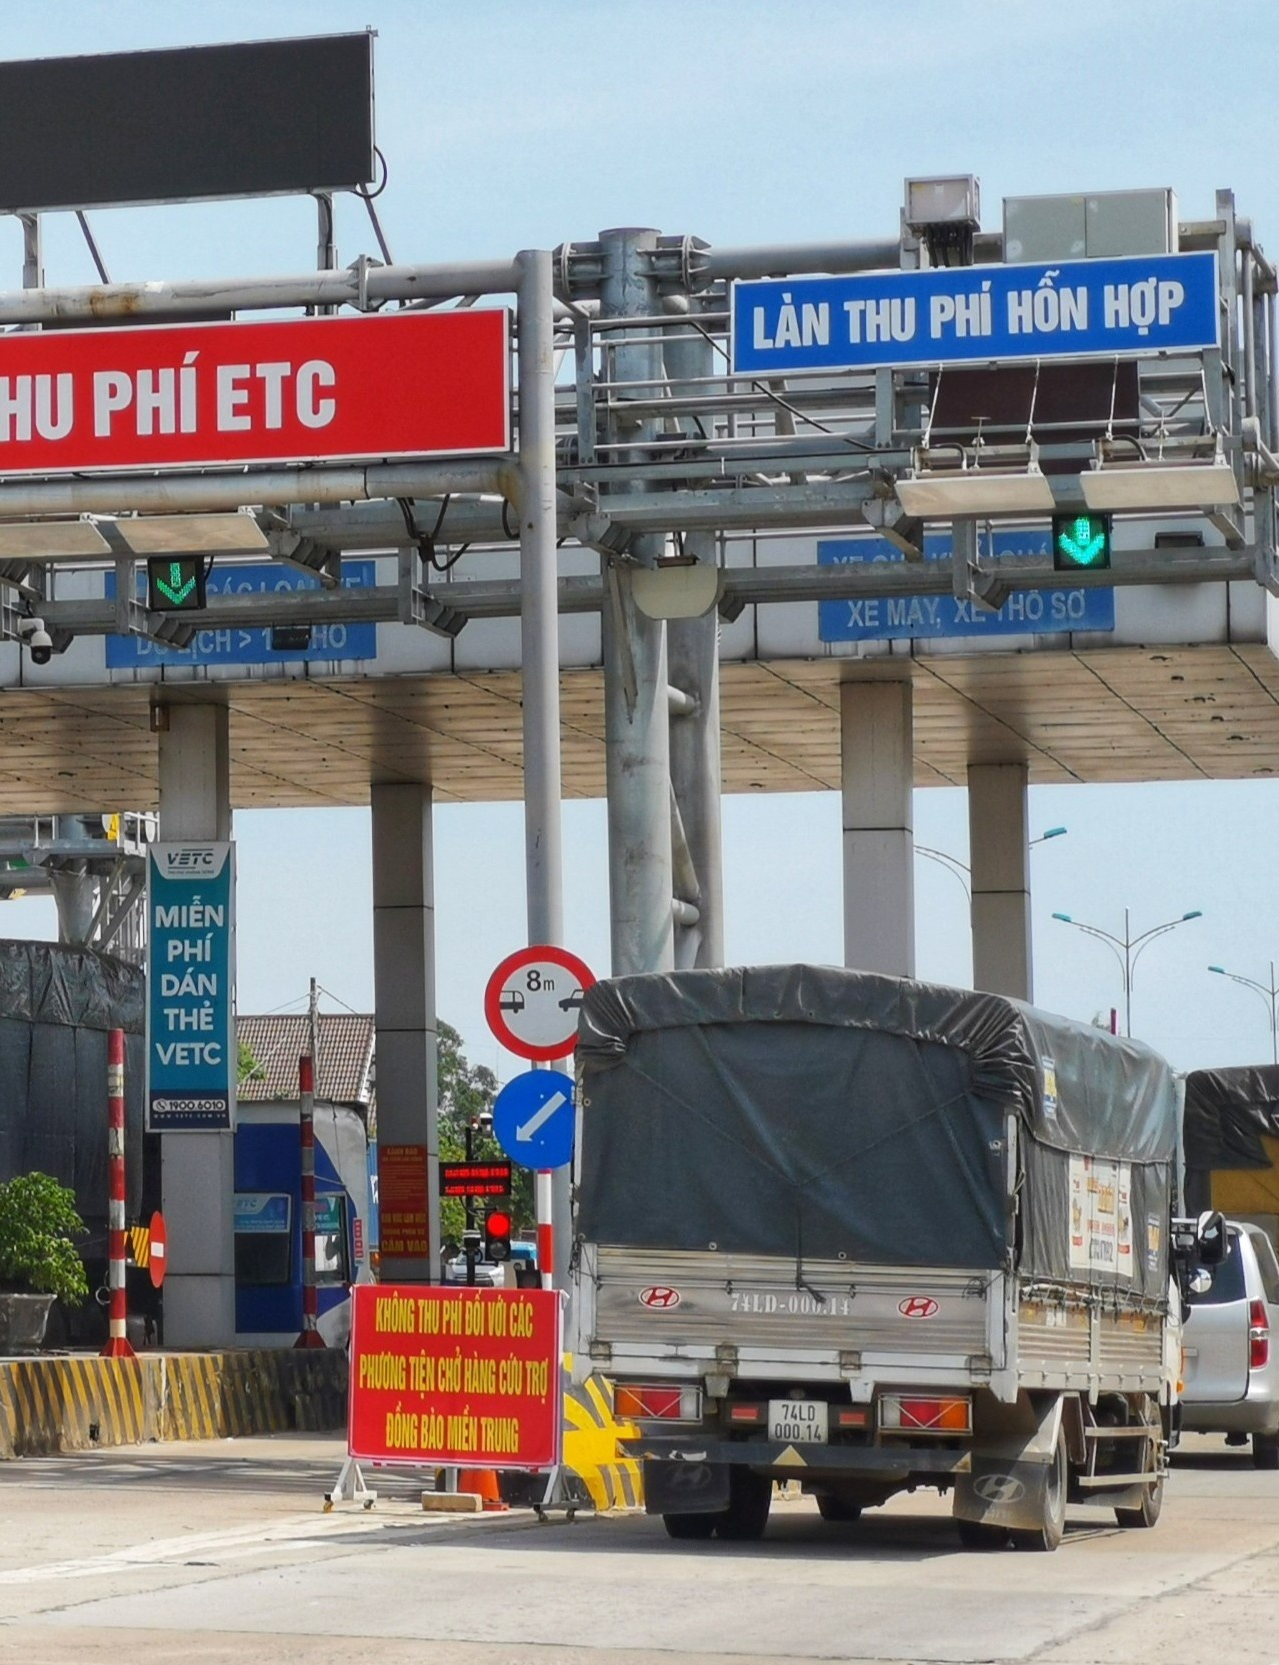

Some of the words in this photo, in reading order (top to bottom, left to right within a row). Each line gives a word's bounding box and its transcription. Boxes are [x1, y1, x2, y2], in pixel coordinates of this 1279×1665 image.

[754, 293, 829, 349] LÀN
[844, 298, 915, 343] THU
[931, 281, 991, 338] PHÍ
[1008, 270, 1087, 333] HỖN
[1104, 277, 1184, 335] HỢP
[94, 351, 199, 437] PHÍ
[217, 360, 335, 431] ETC
[847, 600, 880, 628] XE
[1052, 589, 1086, 619] SƠ
[167, 852, 214, 865] VETC
[155, 895, 224, 928] MIỄN
[168, 932, 214, 962] PHÍ
[161, 967, 217, 997] DÁN
[163, 1000, 214, 1031] THẺ
[155, 1043, 222, 1065] VETC
[168, 1100, 224, 1110] 1900.6010
[376, 1291, 415, 1334] KHÔNG
[418, 1299, 439, 1335] THU
[442, 1293, 463, 1335] PHÍ
[465, 1288, 485, 1336] ĐỐI
[488, 1294, 507, 1337] VỚI
[510, 1295, 533, 1338] CÁC
[731, 1293, 850, 1315] 74LD-000.14
[359, 1351, 406, 1391] PHƯƠNG
[409, 1349, 435, 1400] TIỆN
[438, 1346, 462, 1393] CHỞ
[464, 1351, 496, 1395] HÀNG
[499, 1352, 523, 1396] CỨU
[525, 1357, 549, 1404] TRỢ
[386, 1401, 418, 1449] ĐỒNG
[421, 1406, 444, 1451] BÀO
[447, 1404, 478, 1452] MIỀN
[481, 1417, 519, 1453] TRUNG
[782, 1404, 815, 1421] 74LD
[775, 1422, 821, 1441] 000.14
